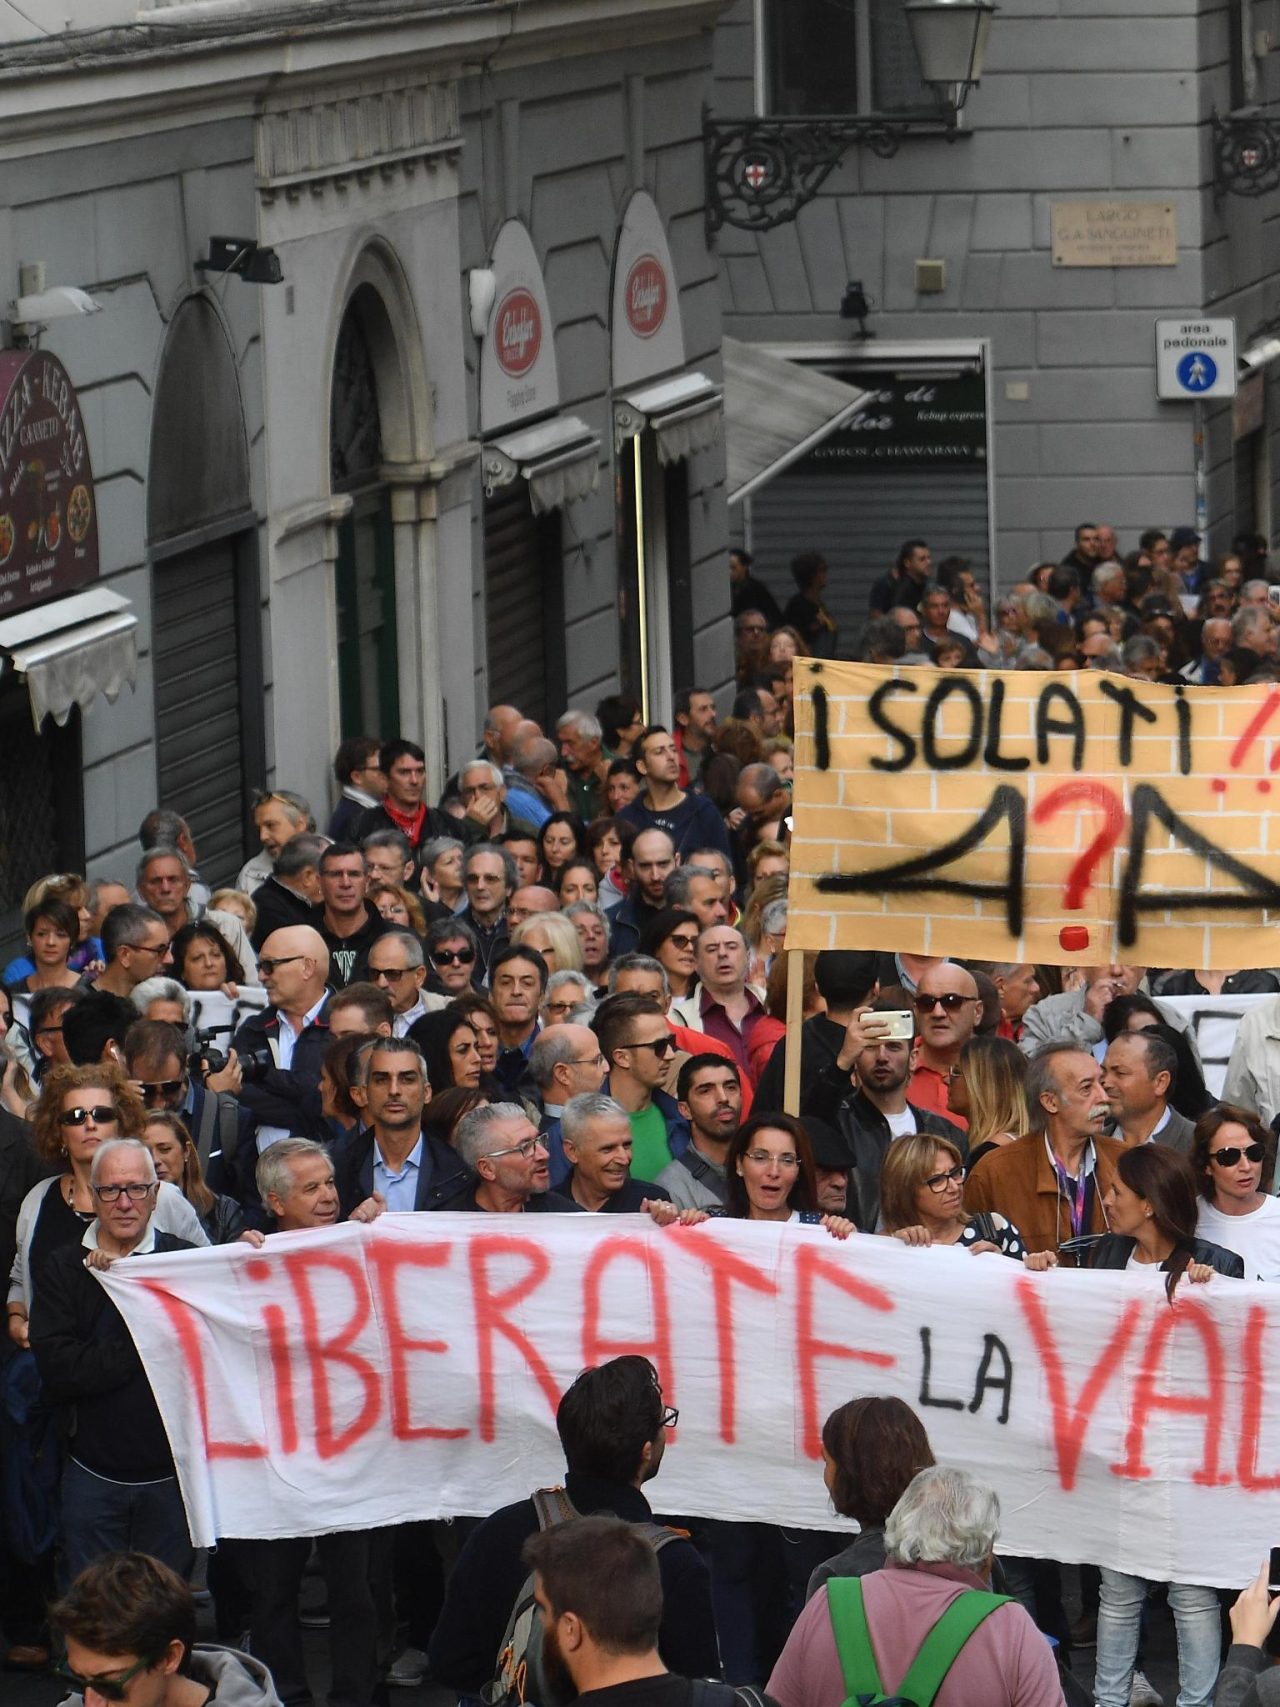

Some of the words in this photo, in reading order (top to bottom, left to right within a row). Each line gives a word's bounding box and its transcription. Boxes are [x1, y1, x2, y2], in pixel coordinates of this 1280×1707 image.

[1180, 325, 1210, 334] area
[1163, 336, 1227, 350] pedonale
[919, 1326, 1012, 1424] LA
